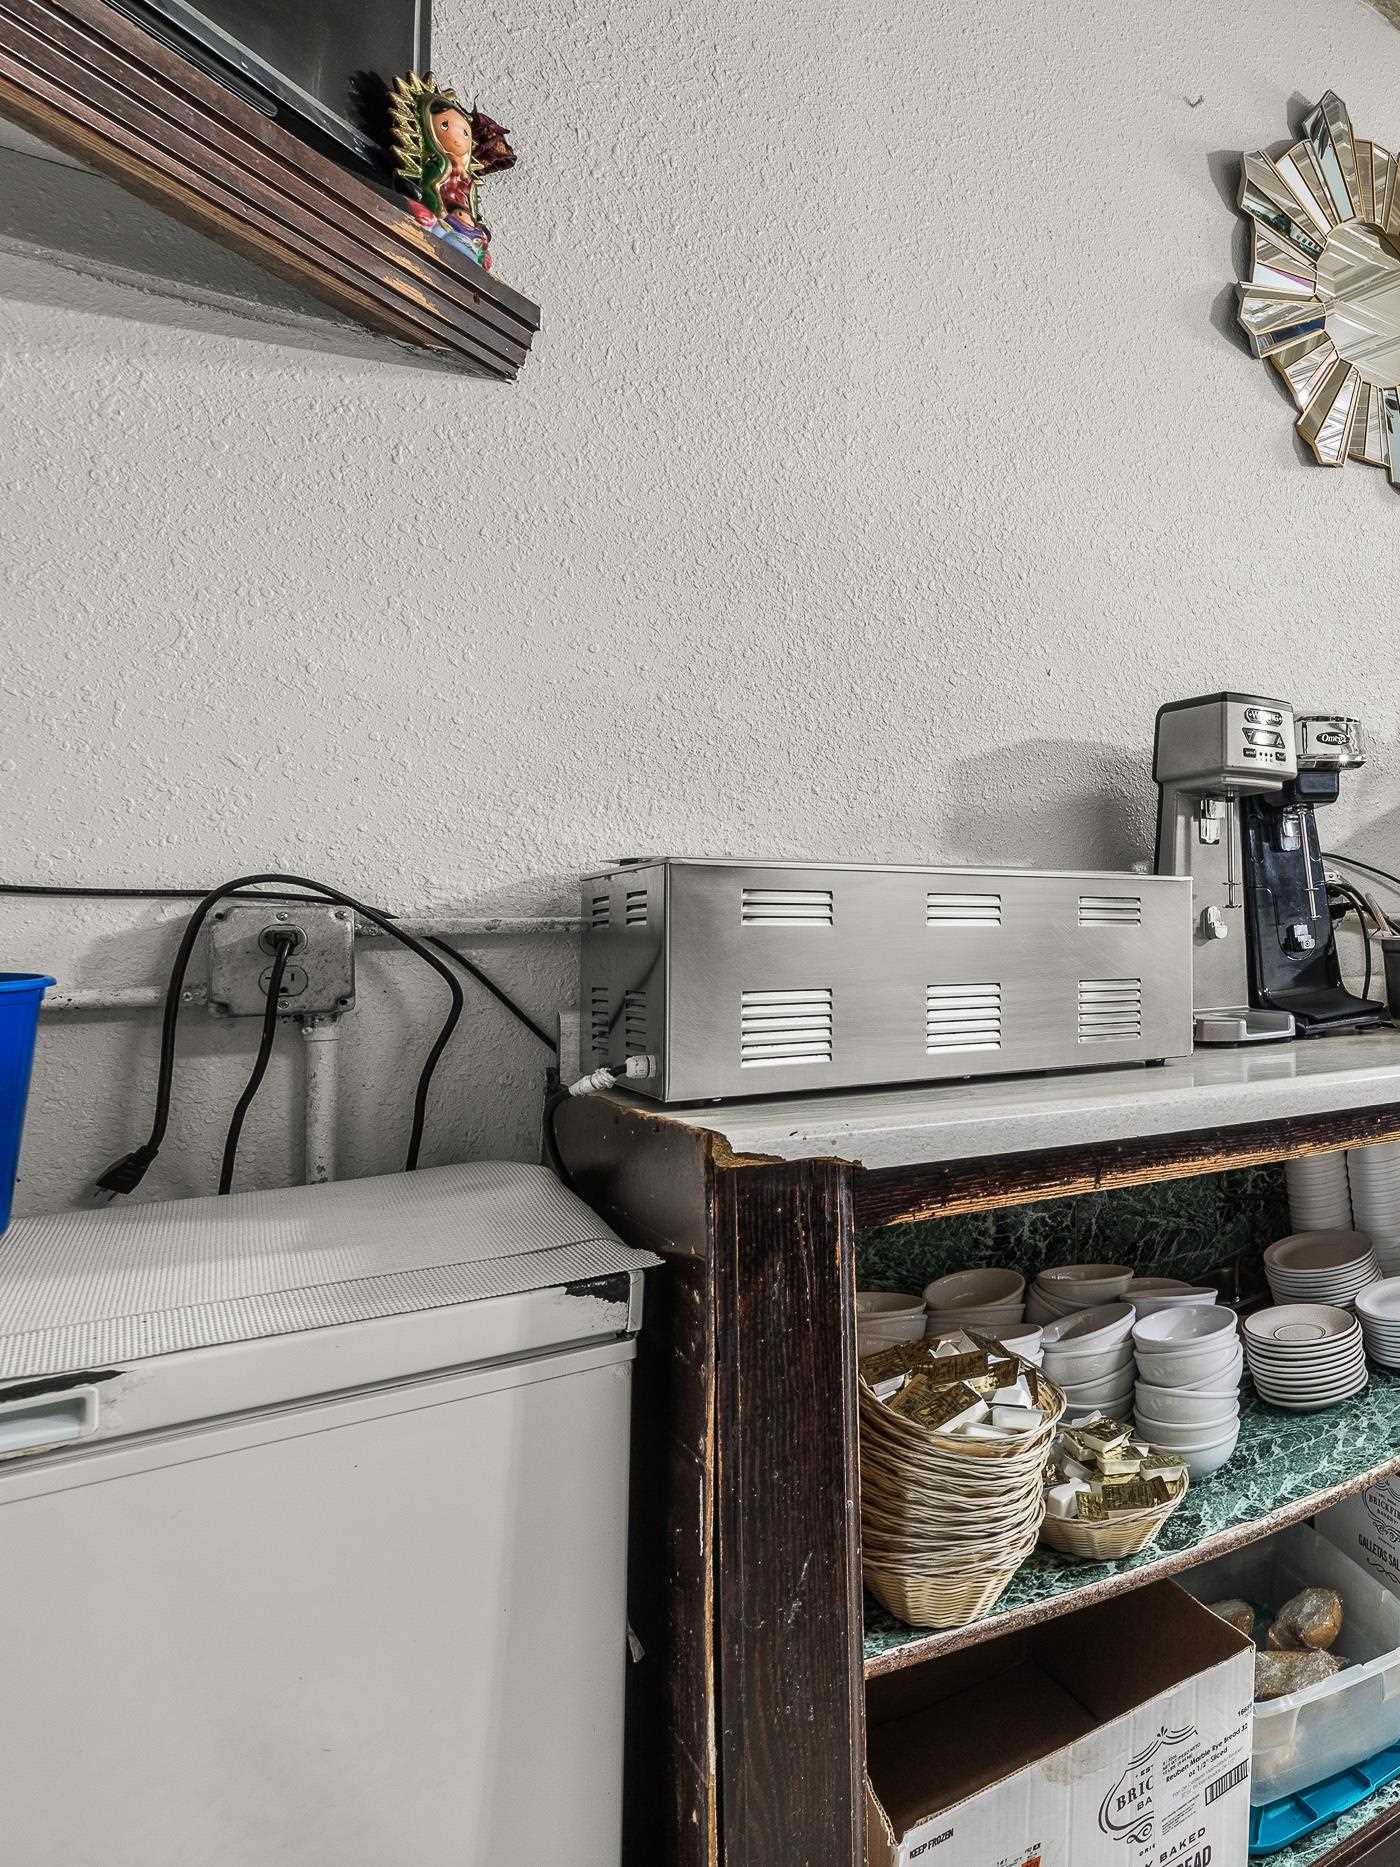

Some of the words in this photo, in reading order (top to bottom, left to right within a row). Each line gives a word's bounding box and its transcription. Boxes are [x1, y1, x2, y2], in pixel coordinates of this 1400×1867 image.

[1321, 733, 1347, 745] Omega
[1358, 1533, 1388, 1563] GALLETAS
[1166, 1763, 1189, 1783] Reuben
[1189, 1749, 1211, 1767] Marble
[1211, 1741, 1223, 1752] Rye
[1223, 1727, 1241, 1743] Bread
[1210, 1746, 1228, 1762] Sliced
[909, 1844, 928, 1859] KEEP
[927, 1828, 954, 1850] FROZEN
[1159, 1827, 1206, 1863] BAKED
